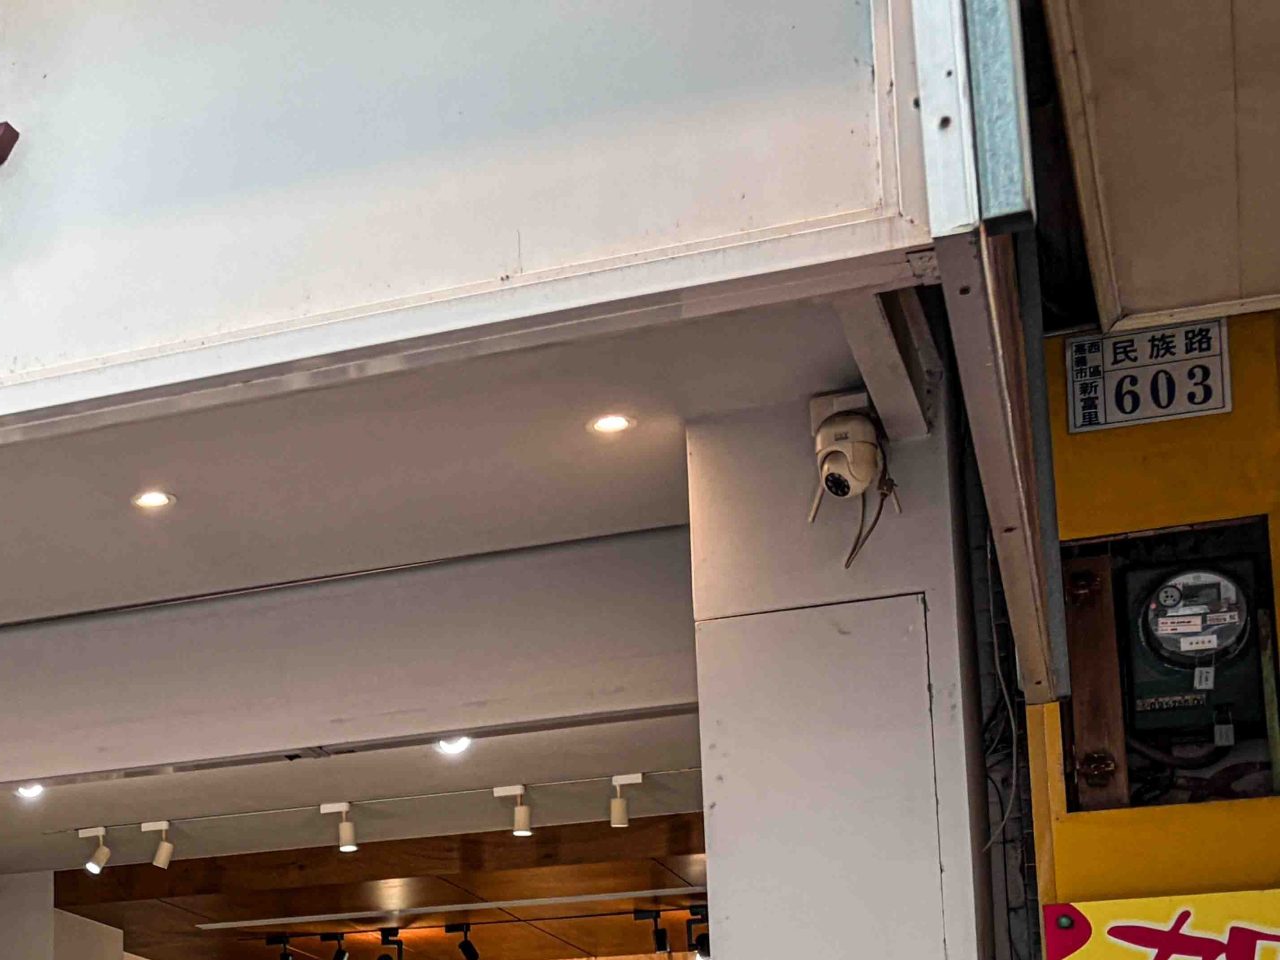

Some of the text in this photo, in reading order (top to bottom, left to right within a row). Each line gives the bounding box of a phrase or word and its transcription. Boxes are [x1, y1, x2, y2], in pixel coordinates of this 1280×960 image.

[1111, 327, 1213, 366] 民族路
[1114, 364, 1214, 415] 603
